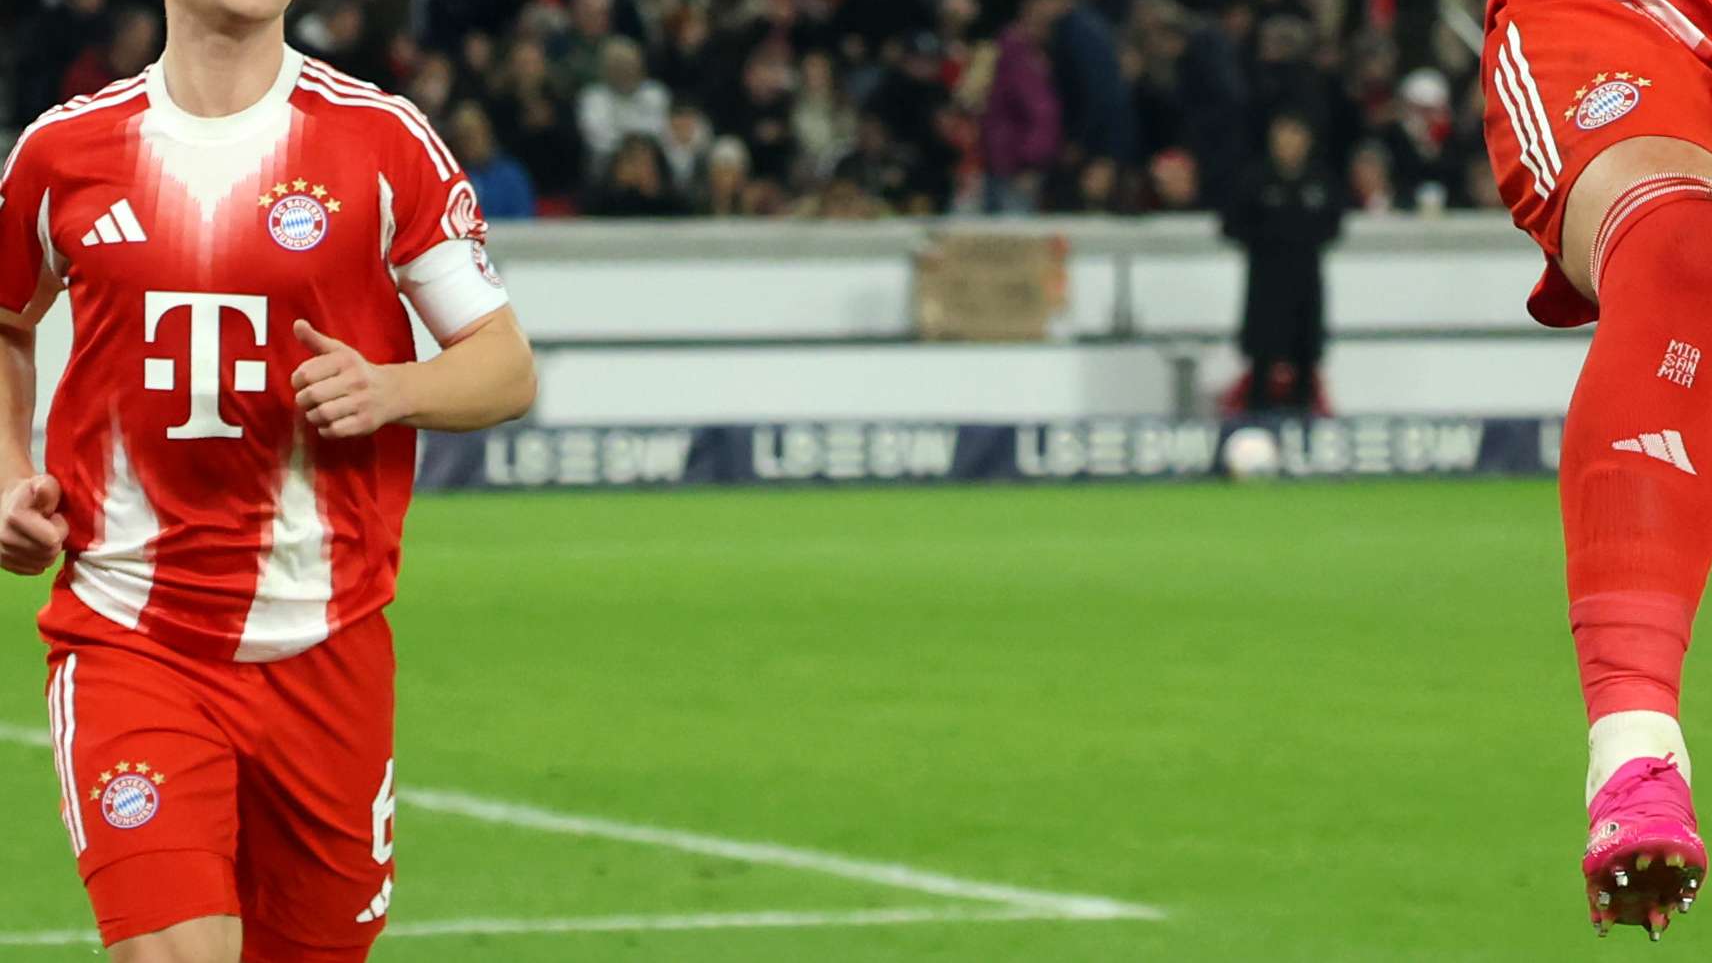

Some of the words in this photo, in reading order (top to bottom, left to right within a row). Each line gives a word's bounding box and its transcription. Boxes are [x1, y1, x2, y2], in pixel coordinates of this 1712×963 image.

[1666, 339, 1701, 364] MIA
[144, 291, 268, 440] T
[1663, 353, 1698, 376] SAN
[1656, 365, 1694, 389] MIA
